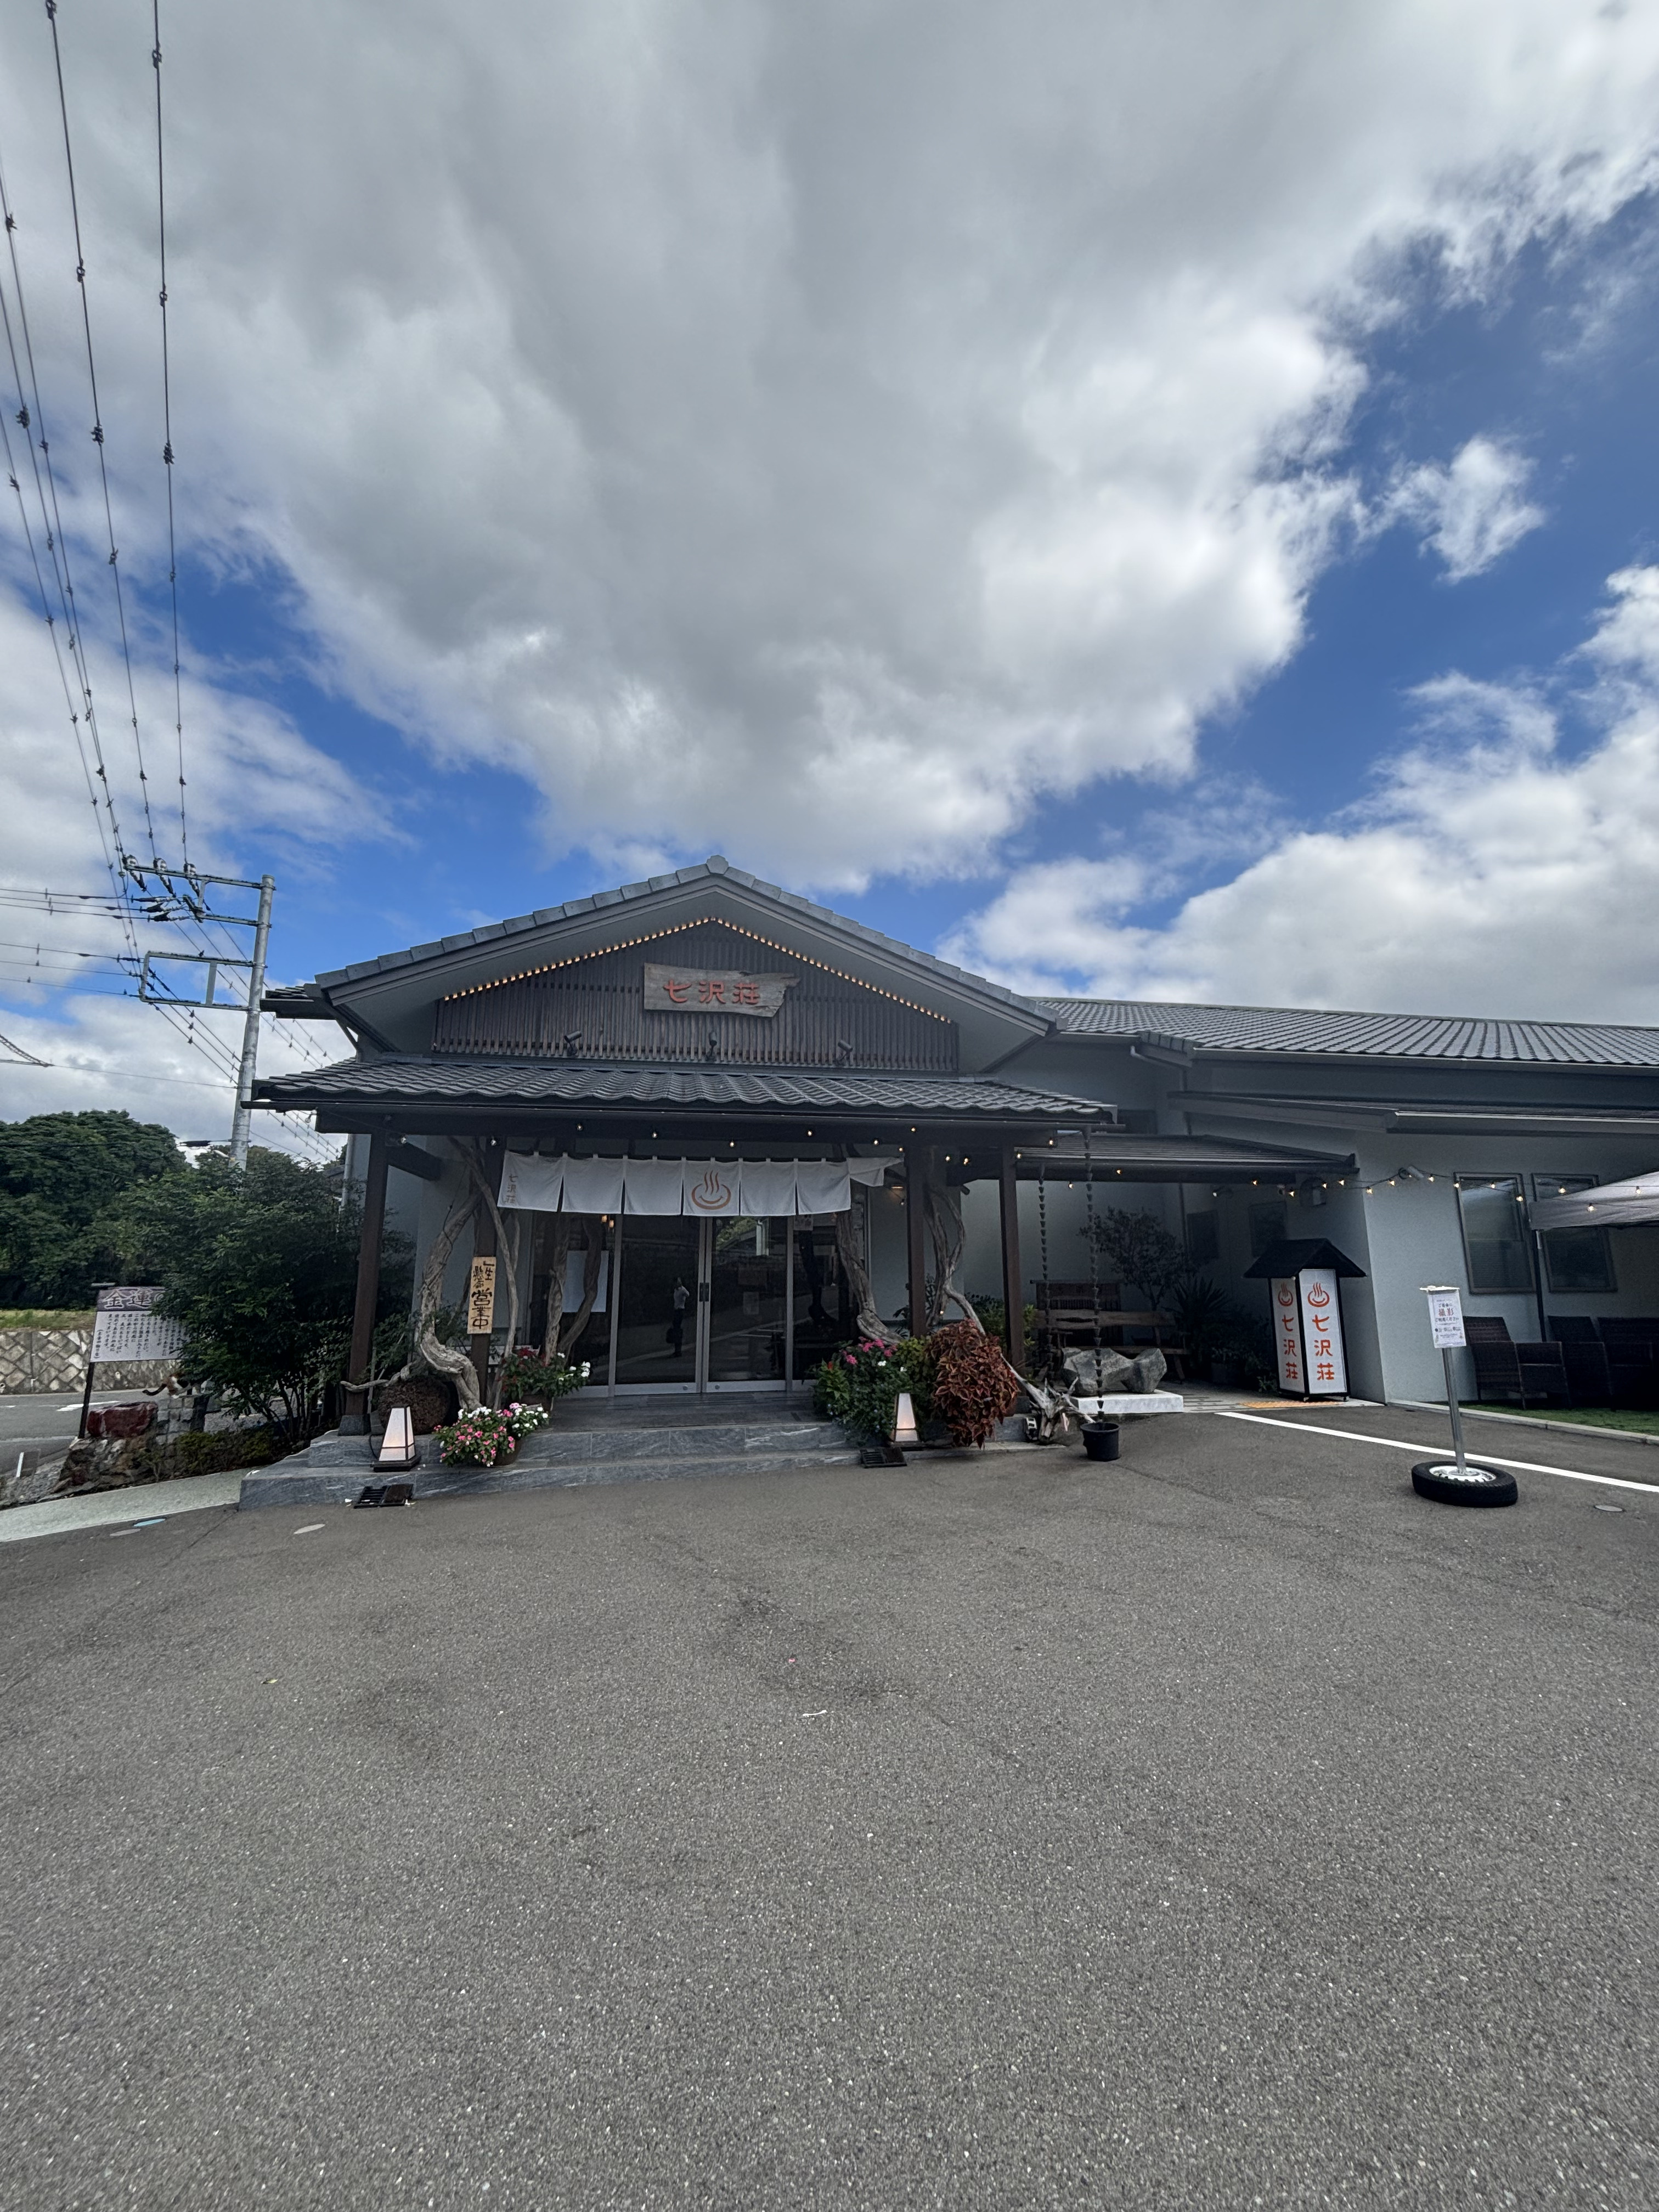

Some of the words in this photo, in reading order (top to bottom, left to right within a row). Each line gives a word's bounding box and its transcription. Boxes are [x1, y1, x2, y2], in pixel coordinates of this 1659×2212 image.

[663, 979, 760, 1005] 七沢荘
[505, 1173, 518, 1203] 七沢荘
[483, 1260, 495, 1281] 一生
[471, 1288, 492, 1329] 営業中
[1282, 1314, 1298, 1380] 七沢荘
[1312, 1314, 1335, 1380] 七沢荘
